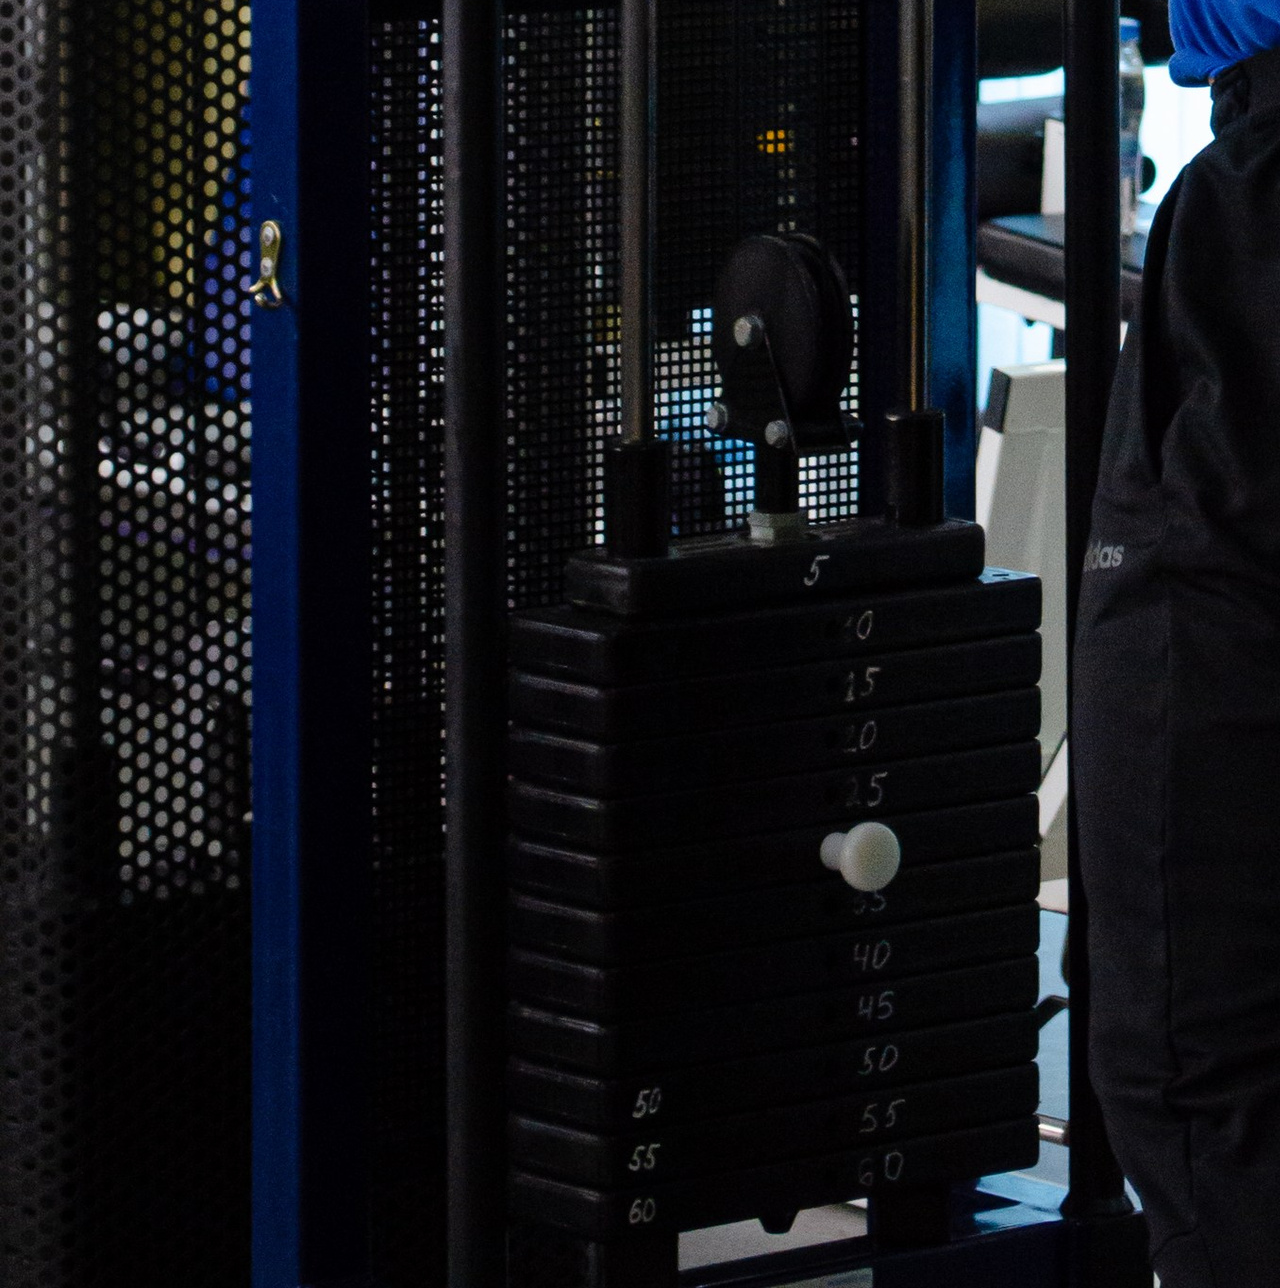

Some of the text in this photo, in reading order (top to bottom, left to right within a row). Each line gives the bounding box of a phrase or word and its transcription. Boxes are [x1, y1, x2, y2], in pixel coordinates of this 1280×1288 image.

[803, 554, 831, 587] 5
[844, 666, 882, 702] 15
[853, 939, 892, 972] 40
[857, 990, 896, 1021] 45
[857, 1043, 900, 1075] 50
[631, 1086, 662, 1119] 50
[858, 1098, 907, 1134] 55
[628, 1142, 662, 1172] 55
[628, 1197, 657, 1224] 60
